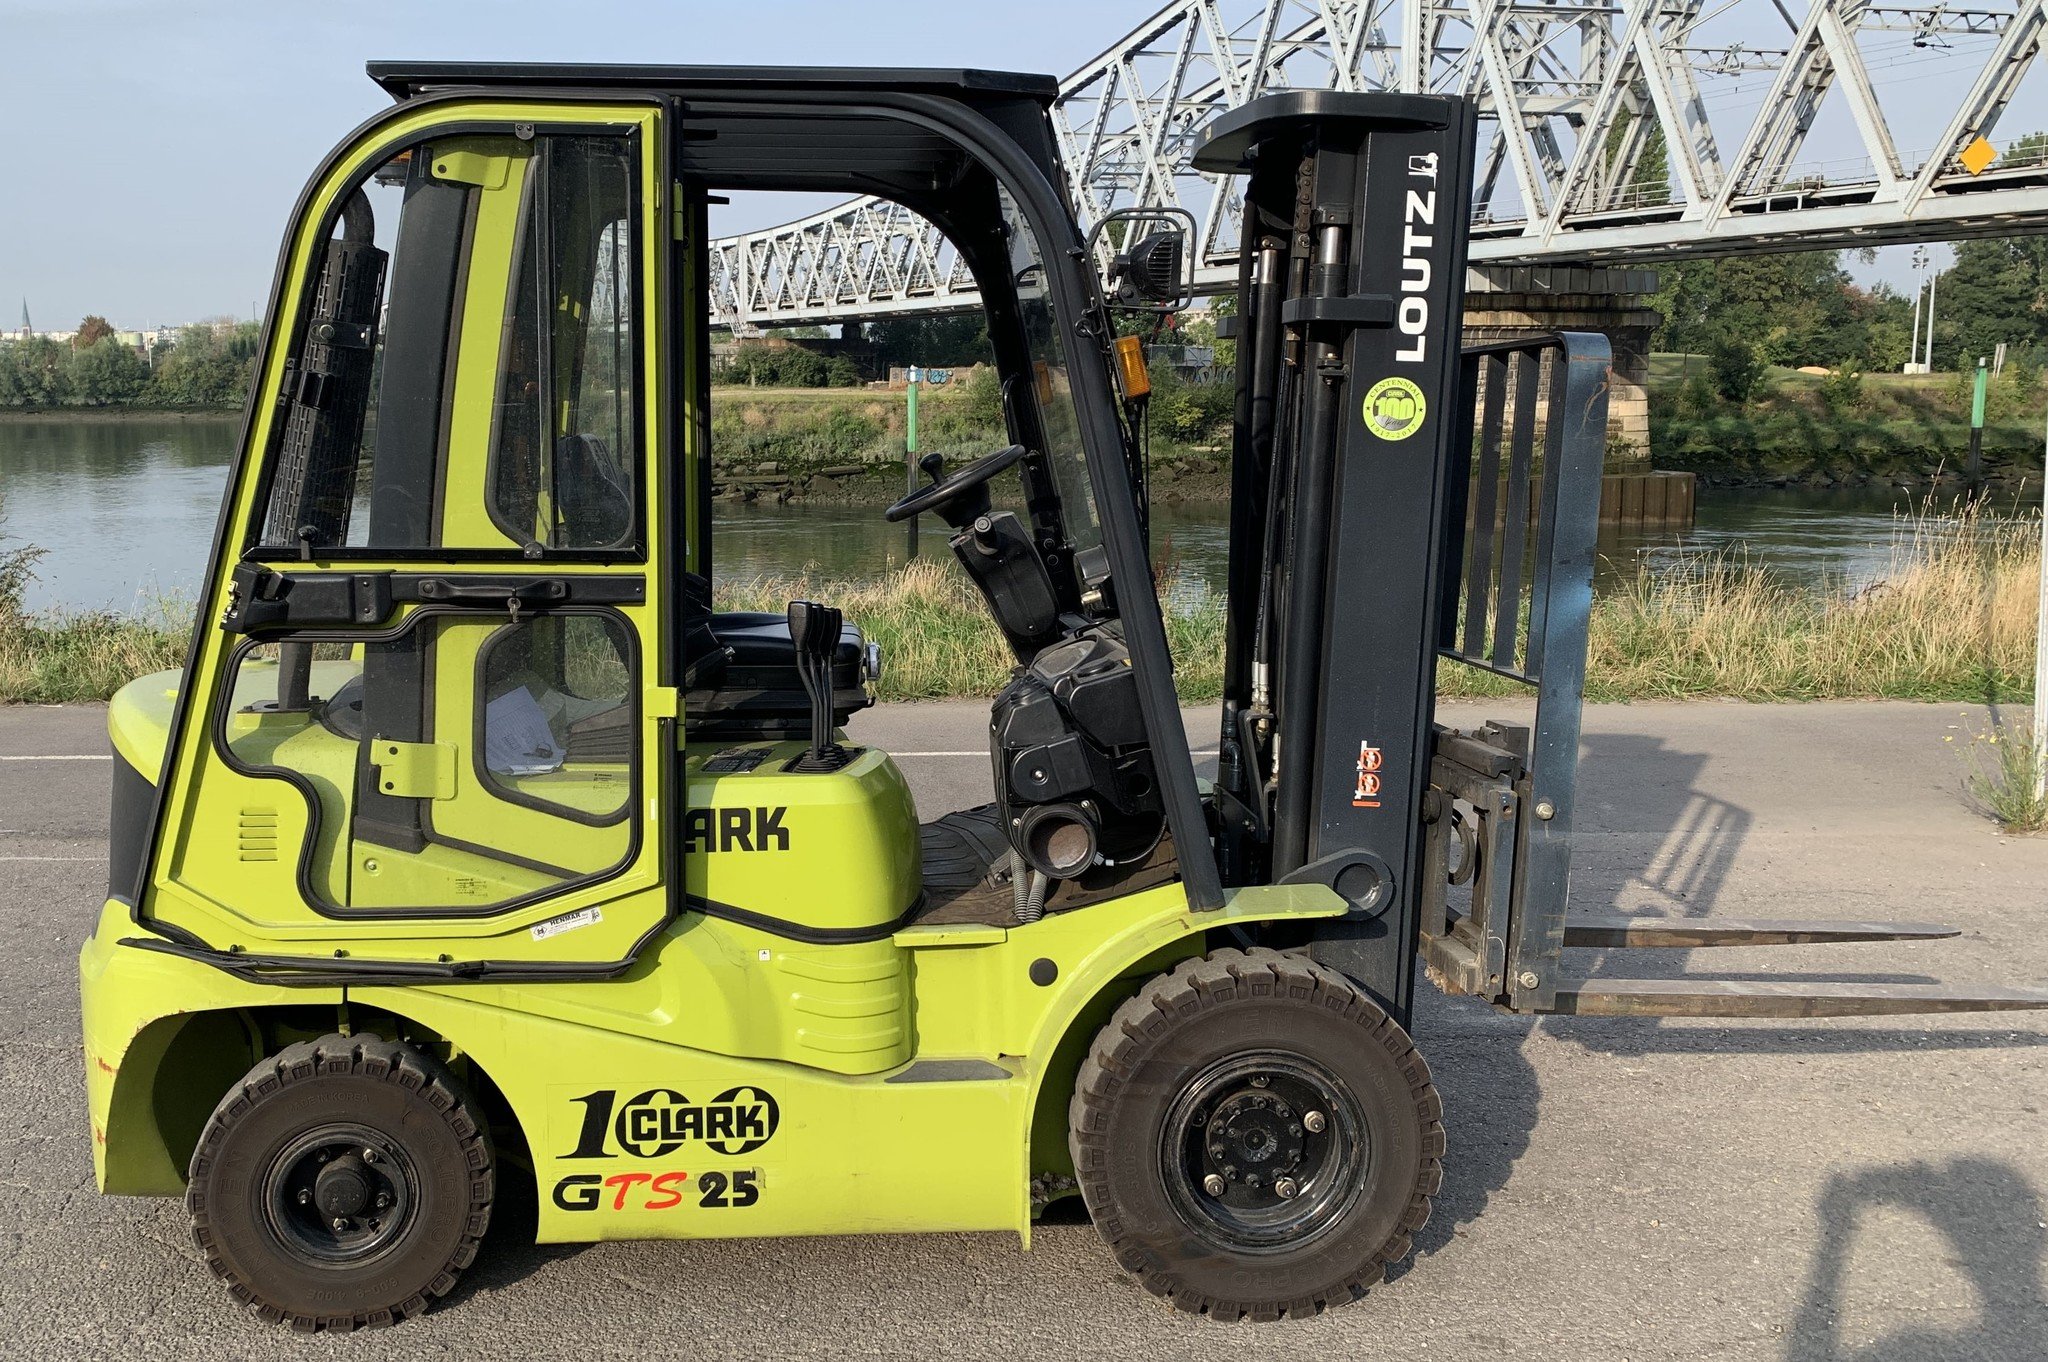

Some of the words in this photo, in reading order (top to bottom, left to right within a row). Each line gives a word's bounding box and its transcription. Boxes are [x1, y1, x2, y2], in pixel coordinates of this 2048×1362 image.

[1395, 190, 1436, 362] LOUTZ
[1369, 379, 1421, 398] CENTENNIAL
[1375, 396, 1415, 420] 100
[1370, 423, 1416, 439] 1917-2017
[685, 806, 790, 853] ARK
[549, 912, 581, 926] HENMAR
[331, 1088, 371, 1106] KOREA
[630, 1104, 765, 1142] CLARK
[552, 1172, 688, 1212] GTS
[698, 1170, 760, 1208] 25
